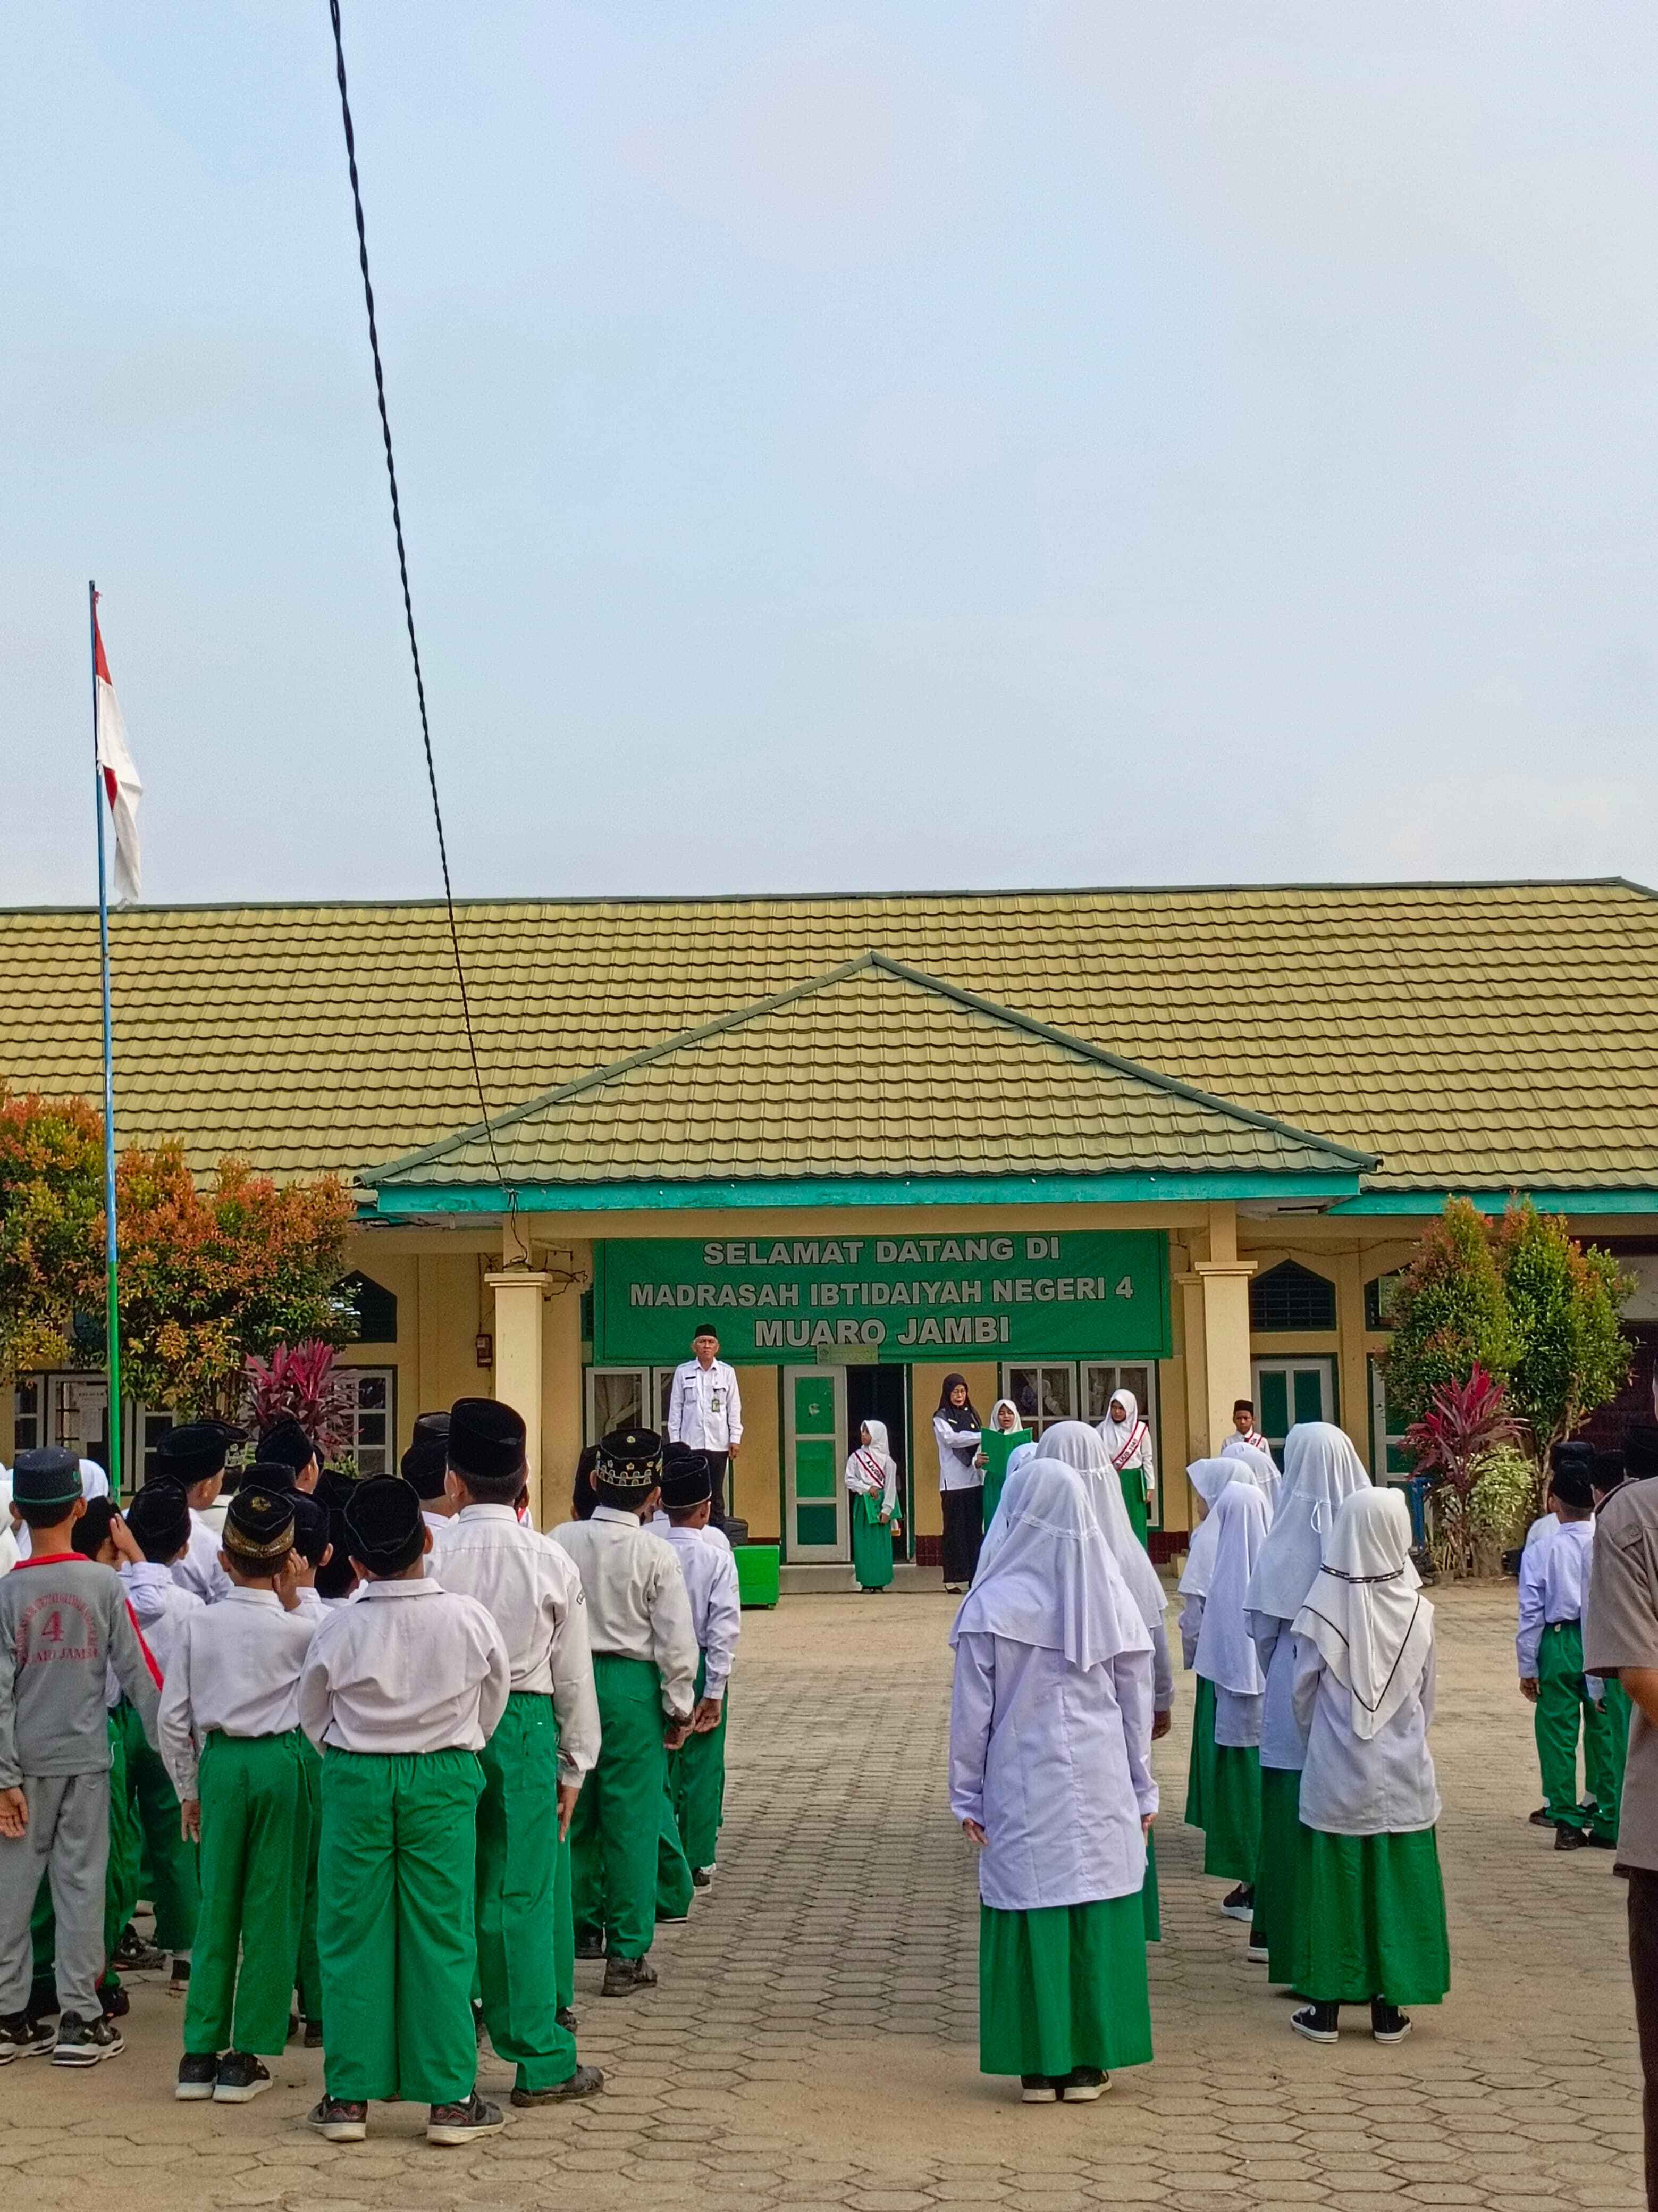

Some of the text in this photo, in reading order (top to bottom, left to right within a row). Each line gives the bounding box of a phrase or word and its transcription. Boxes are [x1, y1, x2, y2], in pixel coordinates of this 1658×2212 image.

[703, 1236, 1060, 1265] SELAMAT DATANG DI
[630, 1276, 1134, 1306] MADRASAH IBTIDAIYAH NEGERI 4
[755, 1316, 1009, 1347] MUARO JAMBI
[41, 1611, 64, 1641] 4
